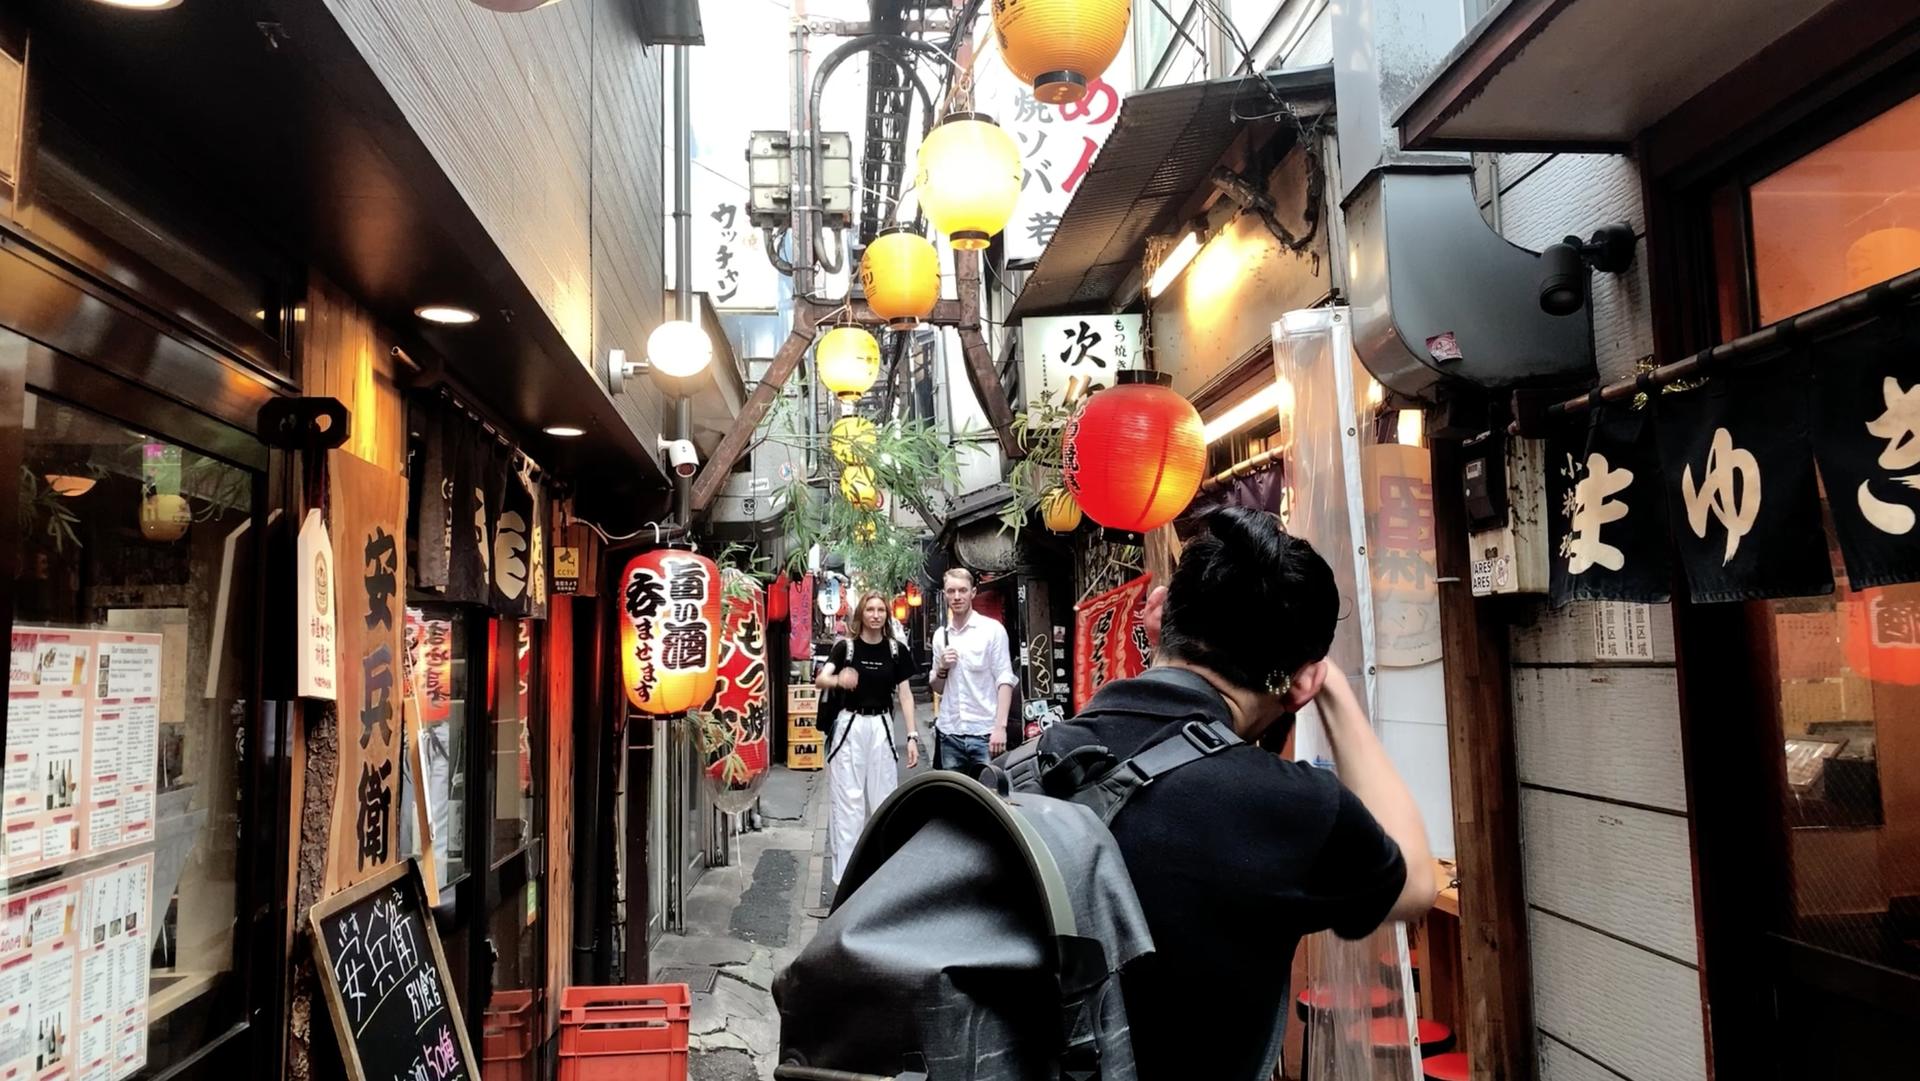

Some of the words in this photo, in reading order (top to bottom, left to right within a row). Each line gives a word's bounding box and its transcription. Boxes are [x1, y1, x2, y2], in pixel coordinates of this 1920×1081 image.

[710, 202, 739, 303] ウッチャン
[661, 560, 707, 670] 旨い酒
[1473, 576, 1490, 588] ARES
[626, 572, 666, 703] 呑ませます
[357, 526, 397, 873] 安兵衛
